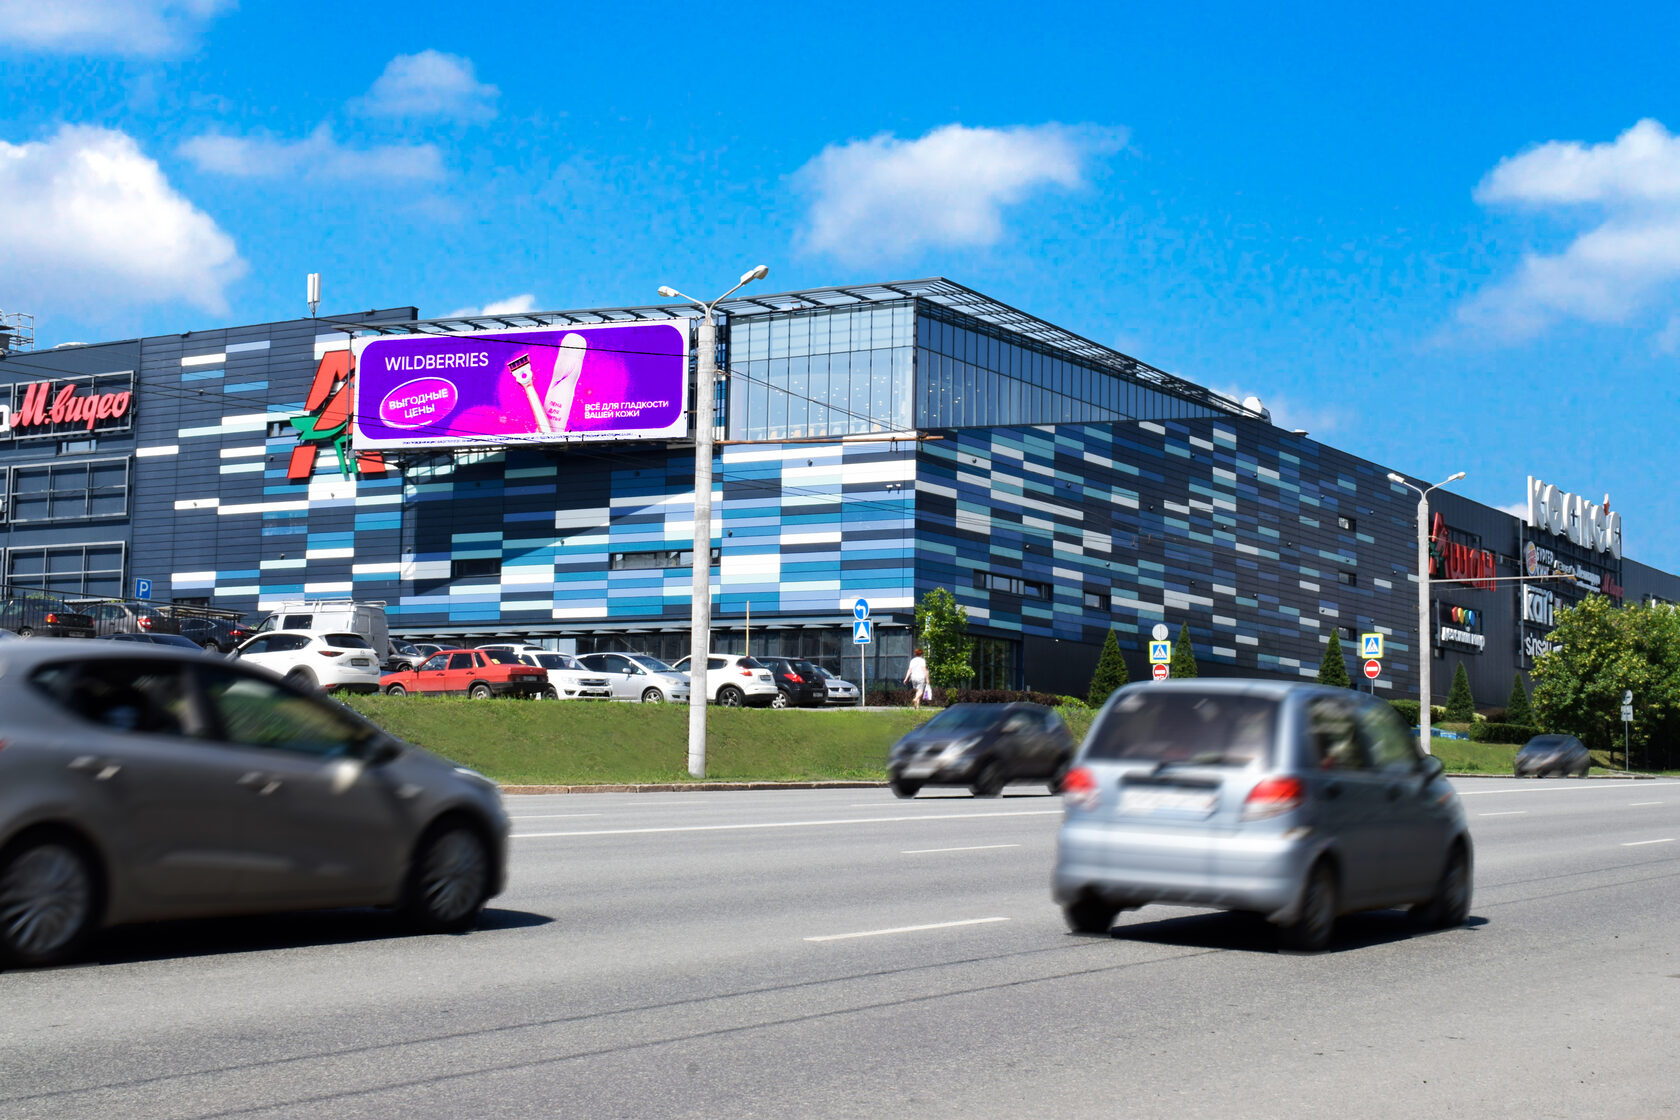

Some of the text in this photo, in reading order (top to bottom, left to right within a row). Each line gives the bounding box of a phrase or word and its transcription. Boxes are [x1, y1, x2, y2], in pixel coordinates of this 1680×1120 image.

[385, 352, 489, 371] WILDBERRIES
[388, 388, 449, 410] ВЫГОДНЫЕ
[584, 400, 670, 411] ВСЁ ДЛЯ ГЛАДКОСТИ
[404, 403, 436, 419] ЦЕНЫ
[584, 410, 640, 419] ВАШЕЙ КОЖИ
[1523, 583, 1554, 626] kari
